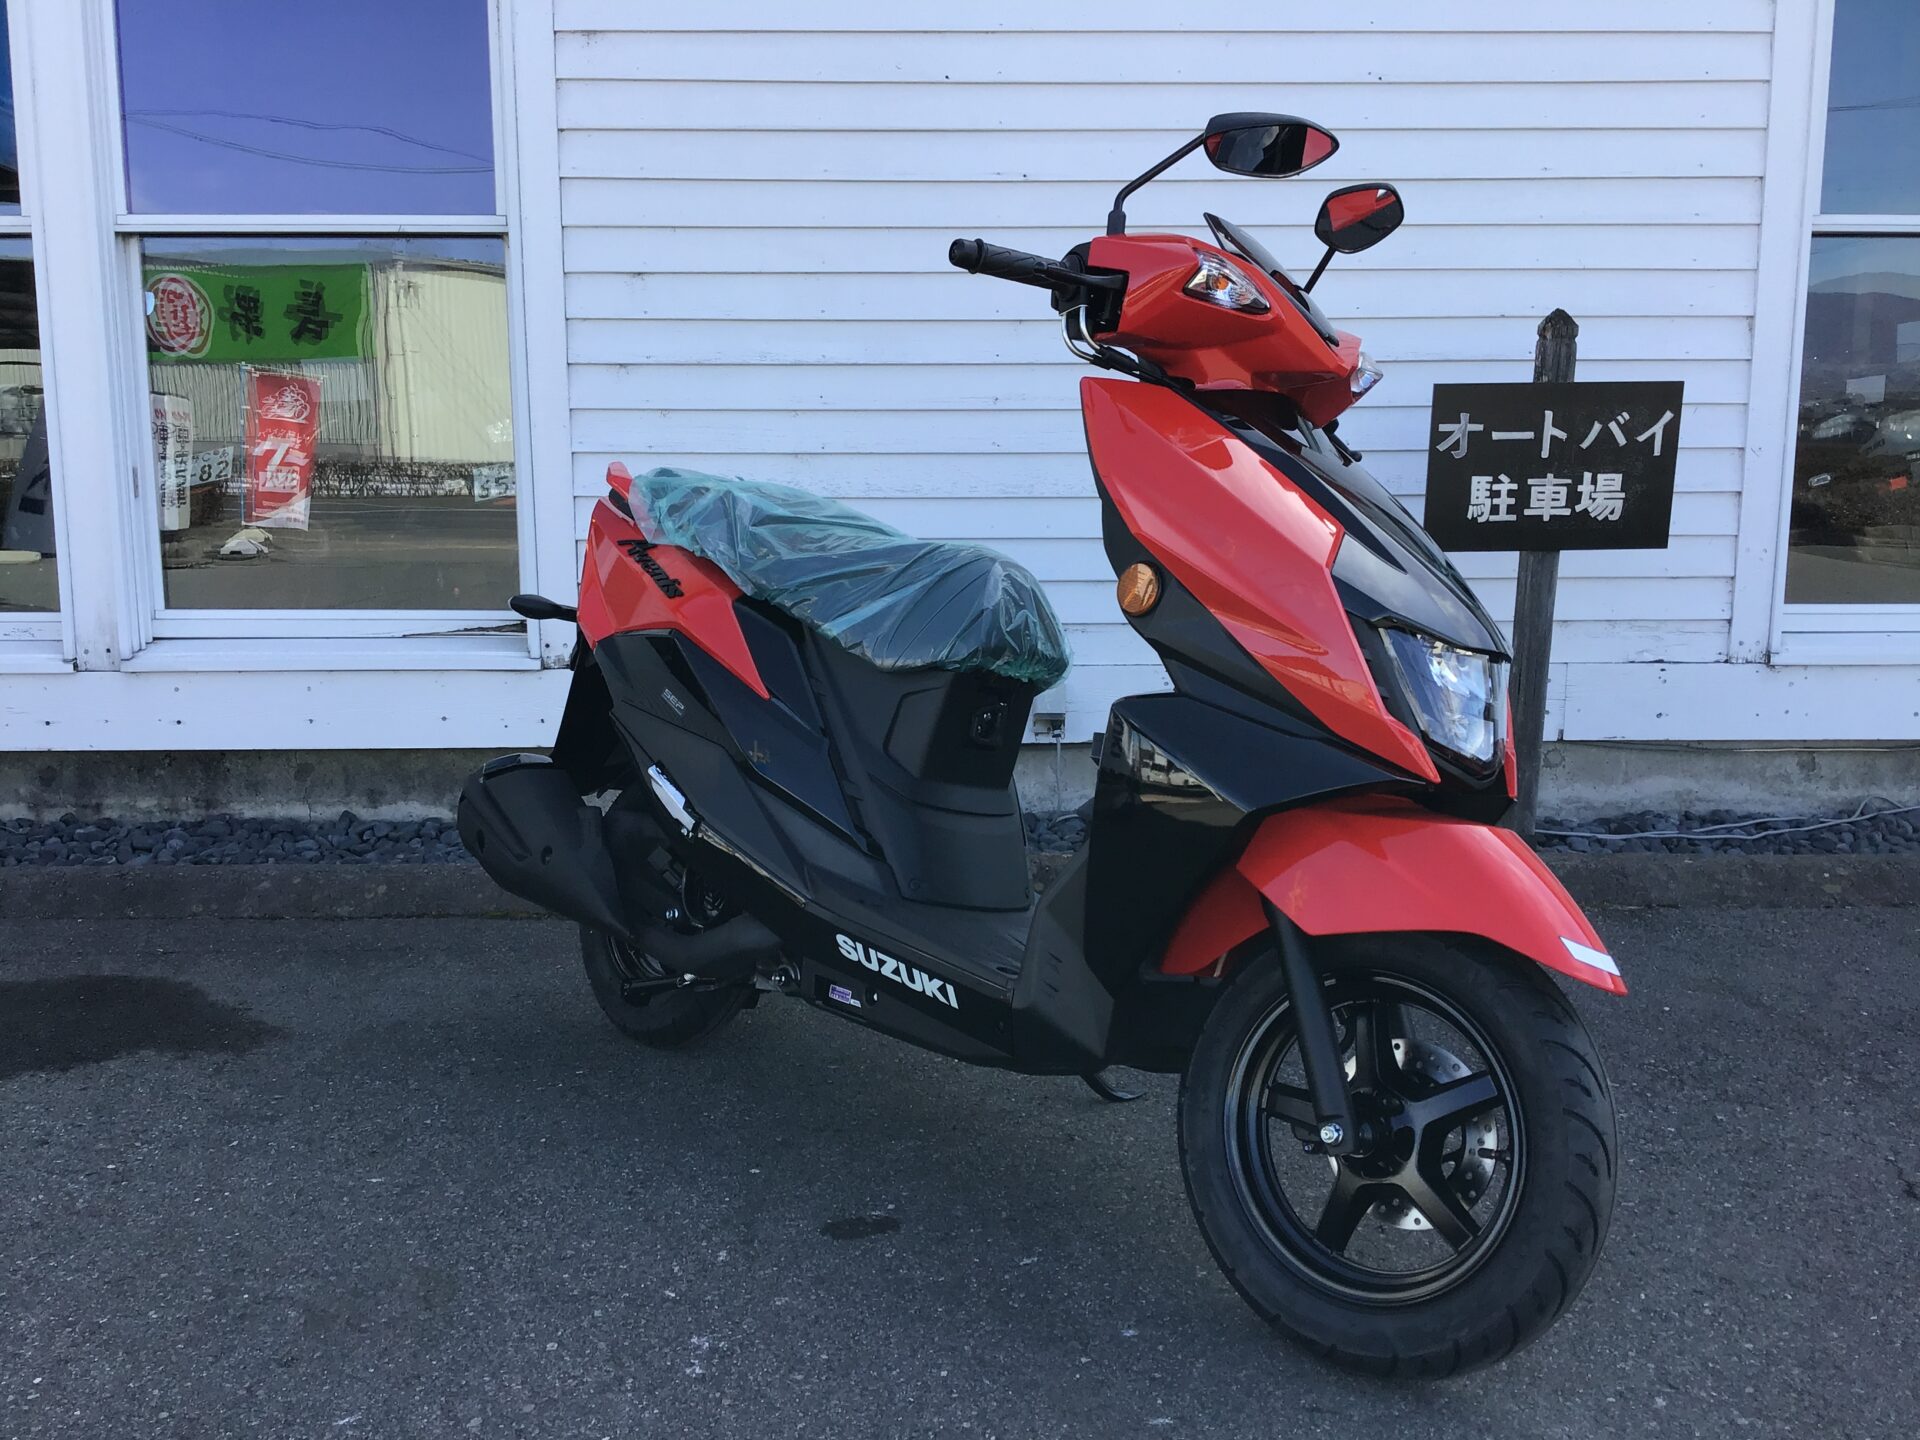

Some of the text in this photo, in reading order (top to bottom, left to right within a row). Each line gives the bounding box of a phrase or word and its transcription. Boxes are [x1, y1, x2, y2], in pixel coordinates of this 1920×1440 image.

[1436, 410, 1674, 459] オートバイ
[1466, 471, 1626, 523] 駐車場
[835, 933, 959, 1010] SUZUKI
